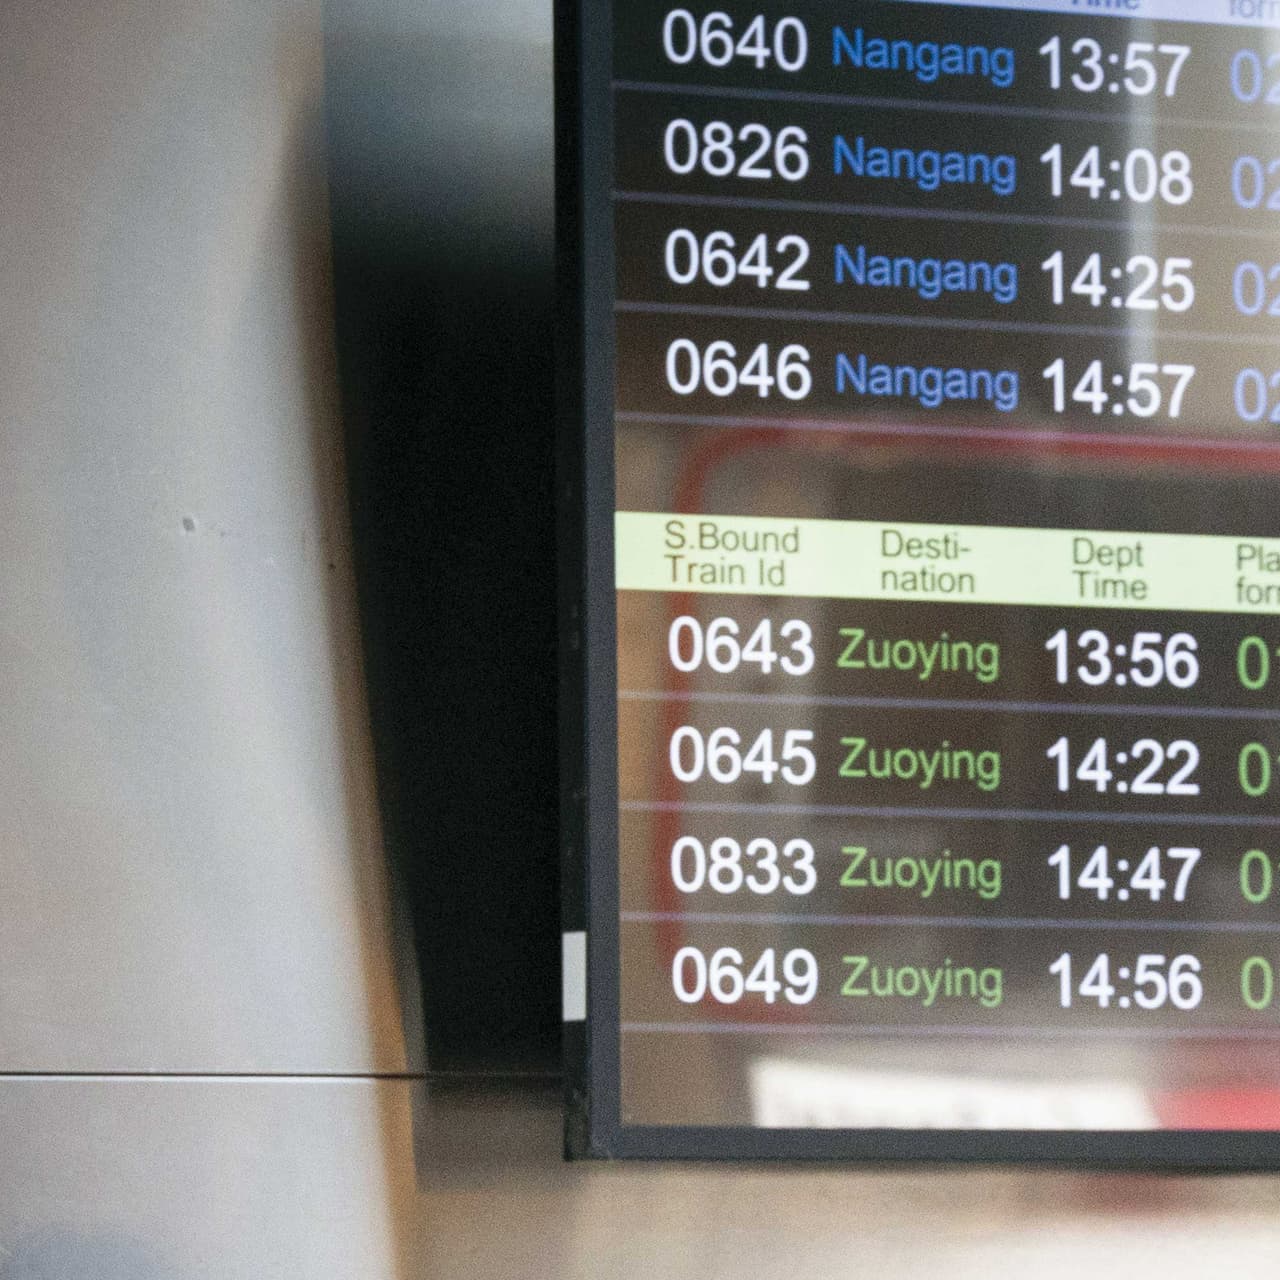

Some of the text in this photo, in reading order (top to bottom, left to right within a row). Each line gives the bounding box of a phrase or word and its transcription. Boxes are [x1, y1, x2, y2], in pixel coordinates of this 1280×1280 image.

[663, 8, 808, 72] 0640
[832, 26, 1015, 88] Nangang
[1040, 37, 1193, 99] 13:57
[664, 118, 809, 182] 0826
[833, 134, 1017, 196] Nangang
[1041, 139, 1195, 207] 14:08
[665, 228, 810, 291] 0642
[834, 243, 1019, 304] Nangang
[1042, 247, 1197, 313] 14:25
[665, 338, 812, 401] 0646
[835, 352, 1020, 413] Nangang
[1043, 355, 1197, 419] 14:57
[664, 518, 801, 557] S.Bound
[880, 530, 972, 562] Desti-
[1072, 537, 1146, 578] Dept
[662, 554, 788, 588] Train Id
[880, 567, 977, 596] nation
[1074, 571, 1148, 600] Time
[668, 615, 815, 677] 0643
[836, 627, 1000, 684] Zuoying
[1045, 629, 1199, 689] 13:56
[670, 725, 816, 786] 0645
[838, 736, 1001, 792] Zuoying
[1046, 737, 1200, 796] 14:22
[671, 836, 817, 895] 0833
[839, 845, 1003, 900] Zuoying
[1048, 845, 1201, 902] 14:47
[672, 946, 819, 1005] 0649
[840, 954, 1004, 1008] Zuoying
[1049, 953, 1203, 1010] 14:56
